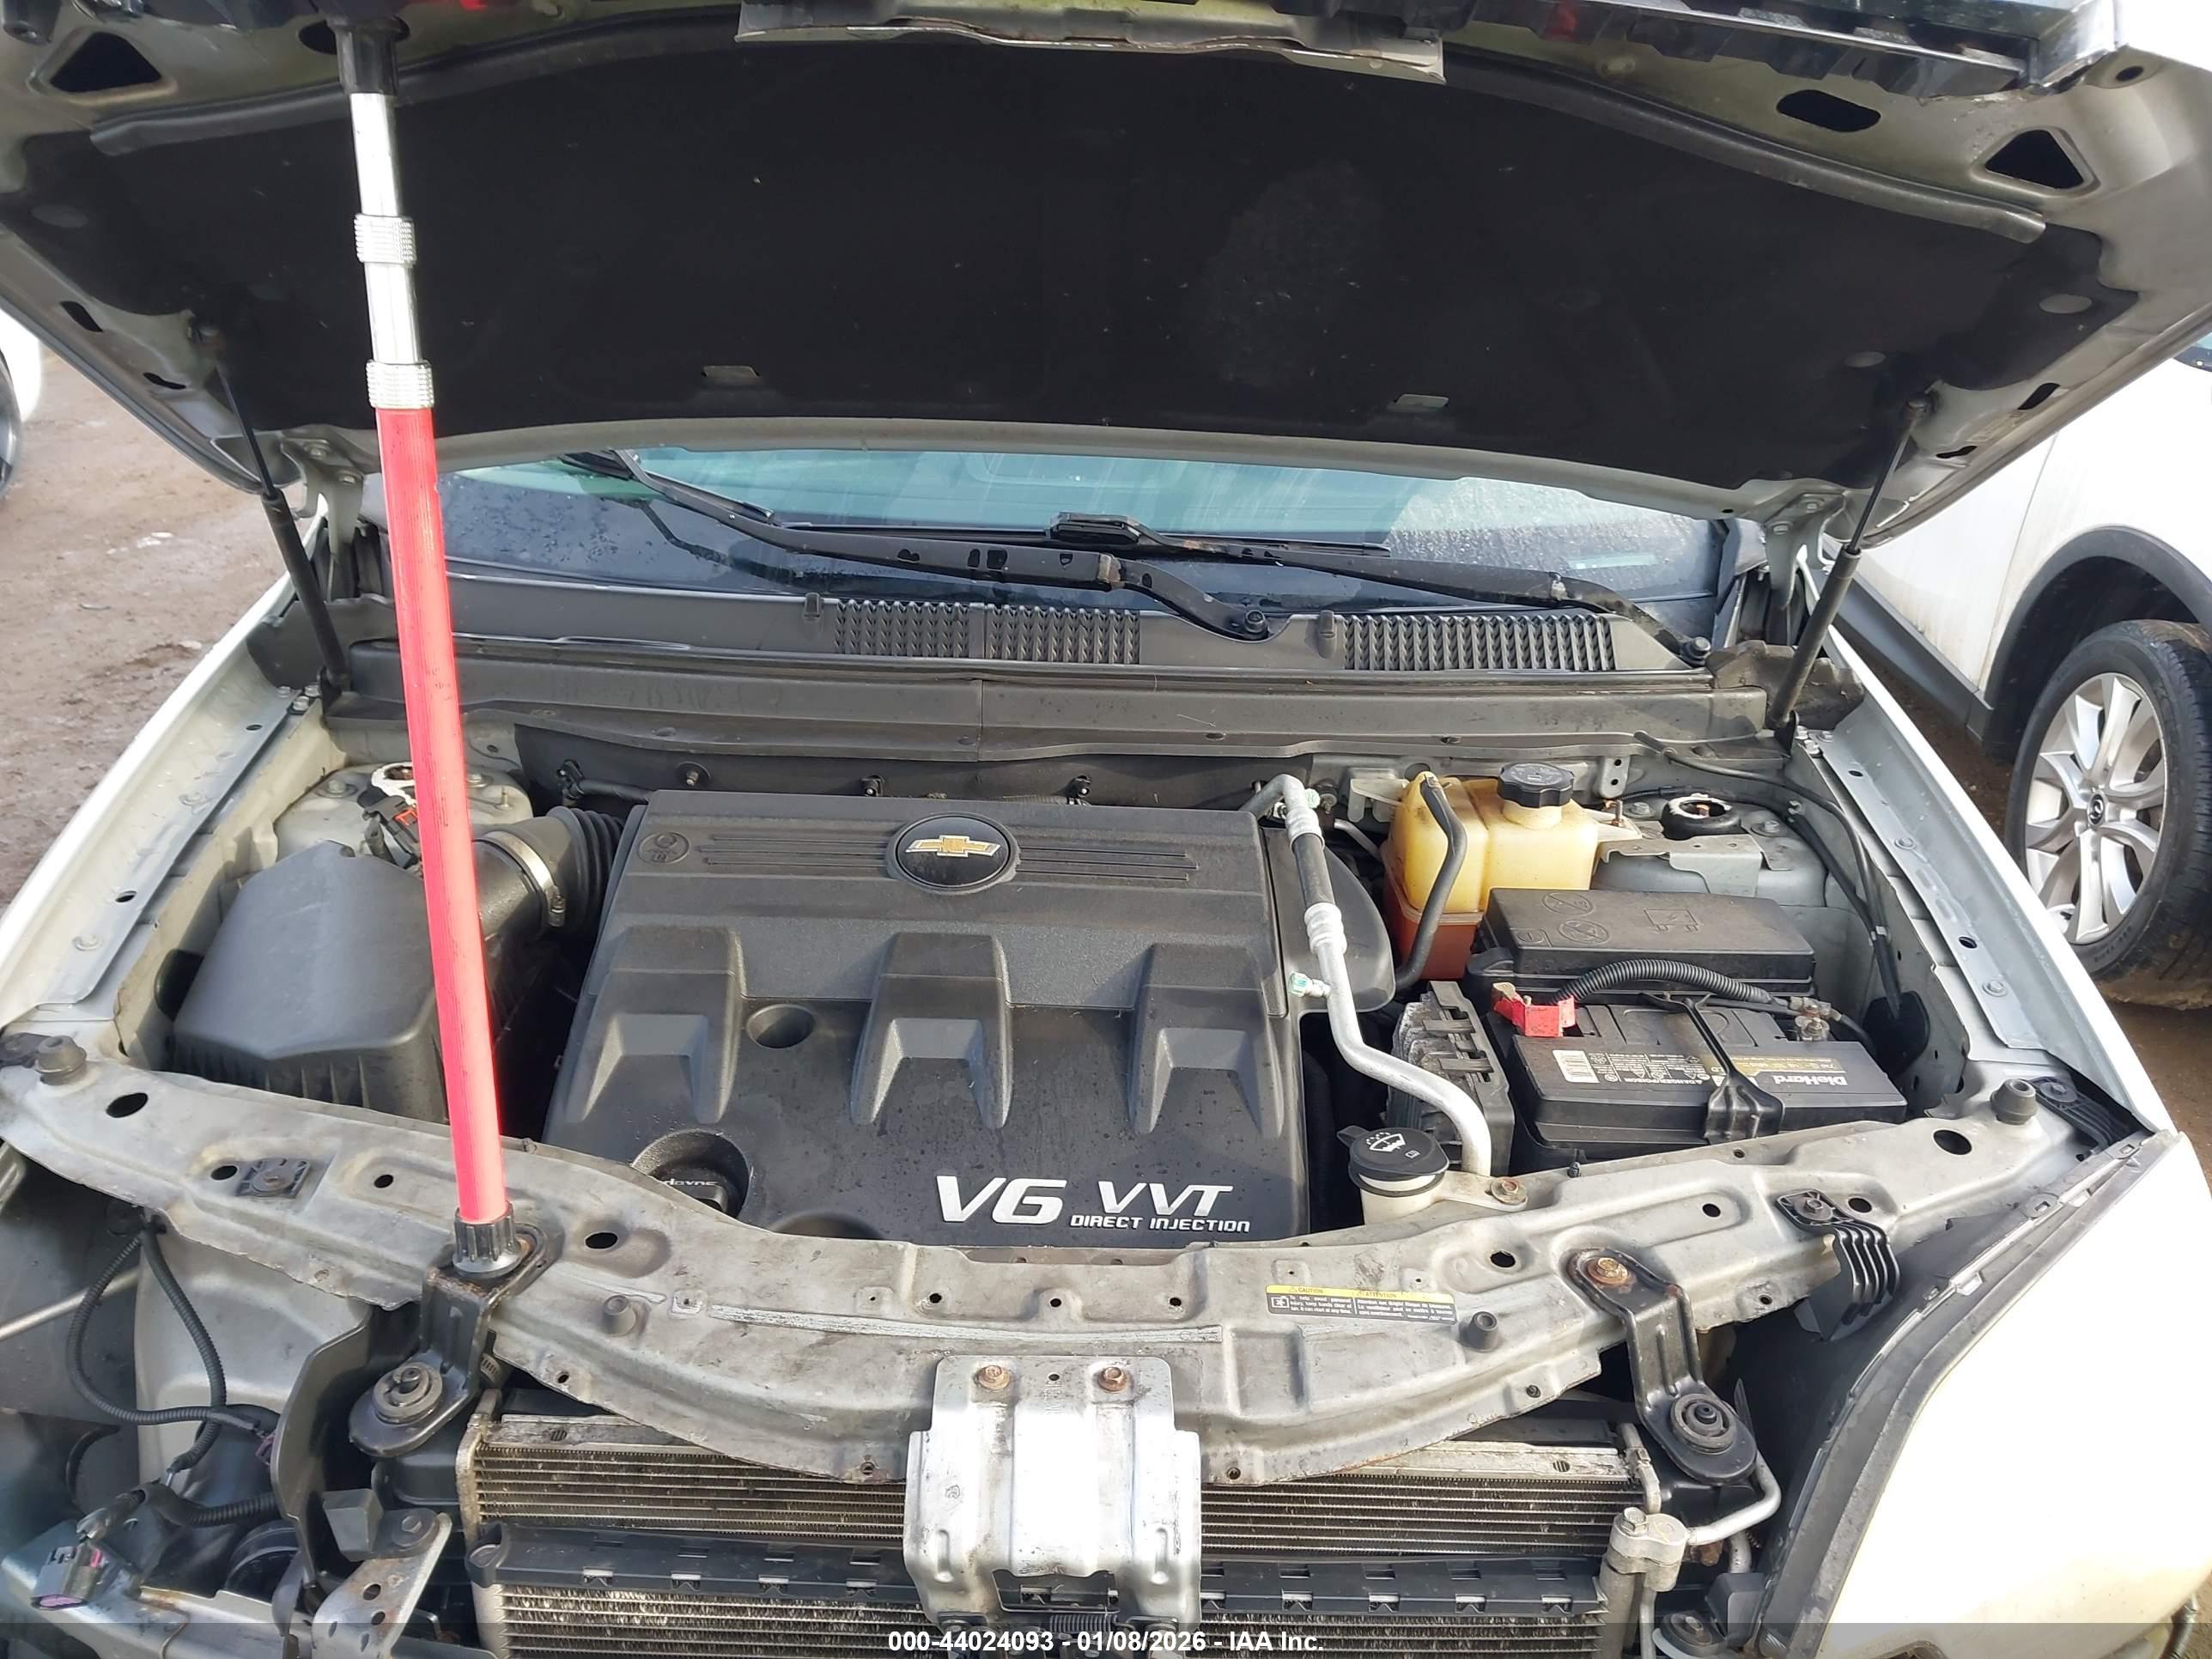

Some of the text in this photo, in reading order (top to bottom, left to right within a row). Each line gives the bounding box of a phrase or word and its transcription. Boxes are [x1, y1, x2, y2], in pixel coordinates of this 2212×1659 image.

[1772, 1075, 1848, 1085] DieHard
[936, 1176, 1067, 1224] V6
[1097, 1181, 1234, 1217] VVT
[1070, 1215, 1250, 1232] DIRECT INJECTION
